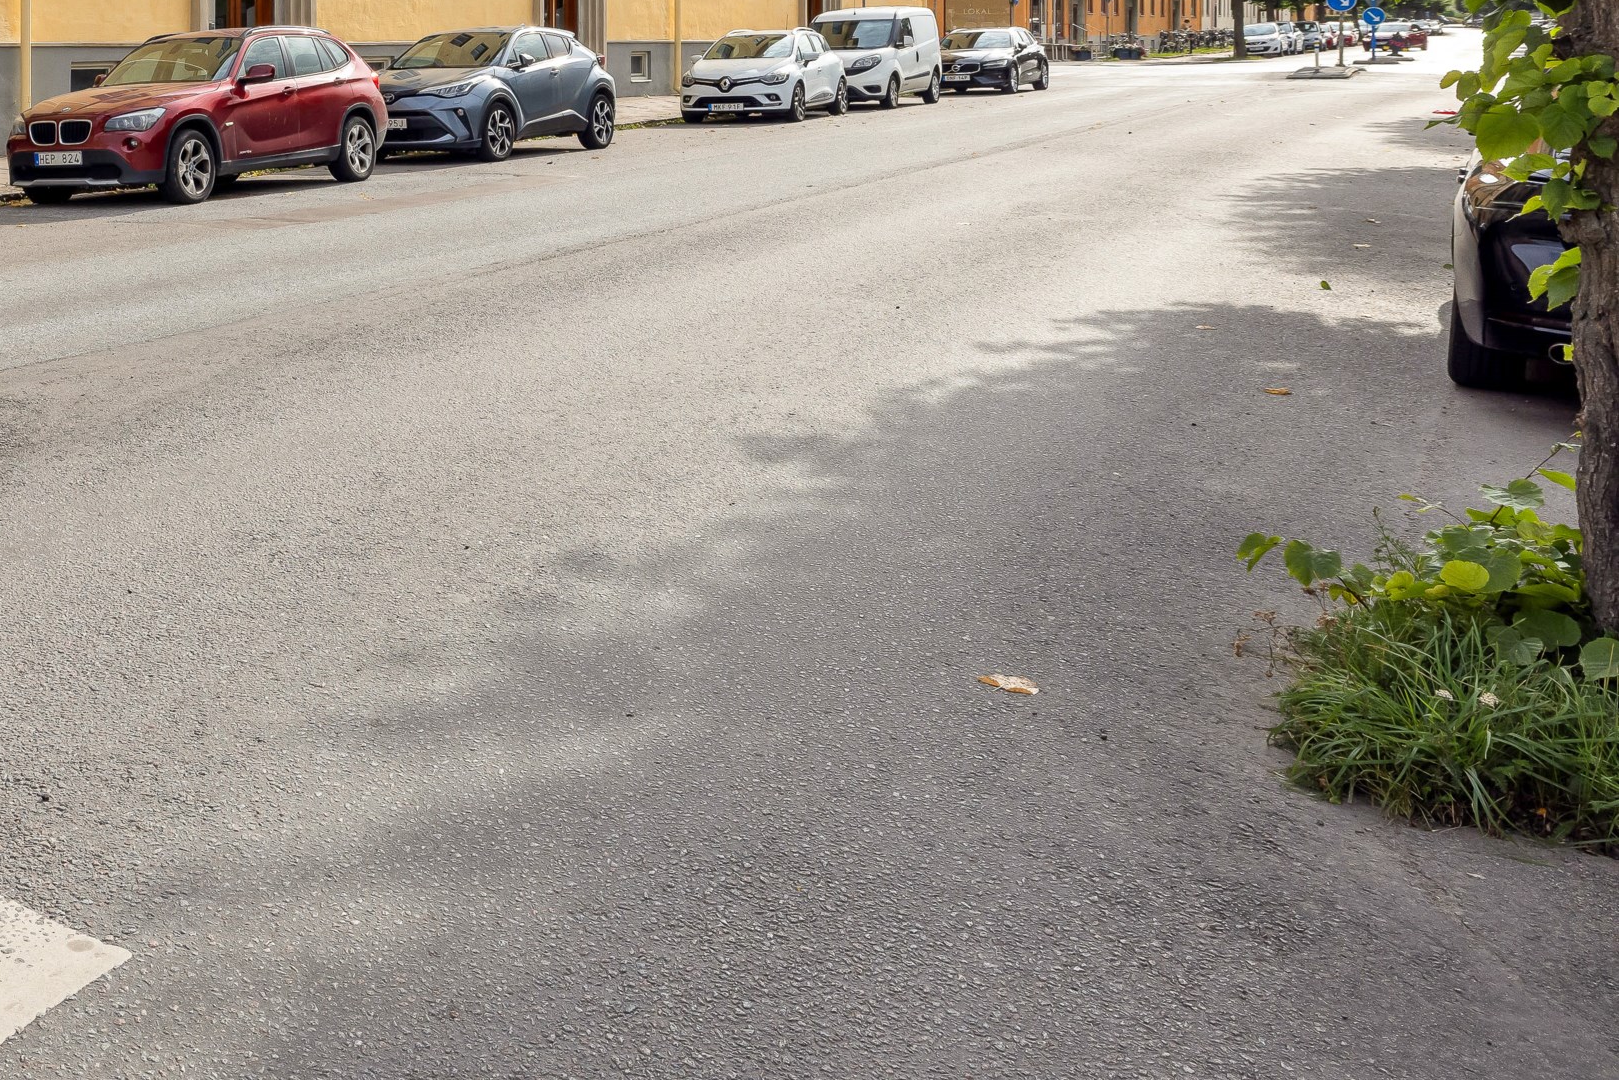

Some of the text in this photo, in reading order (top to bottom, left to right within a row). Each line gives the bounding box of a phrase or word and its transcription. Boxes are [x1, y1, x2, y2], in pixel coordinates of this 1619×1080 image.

[388, 119, 404, 128] 95J
[39, 153, 79, 164] HEP 824
